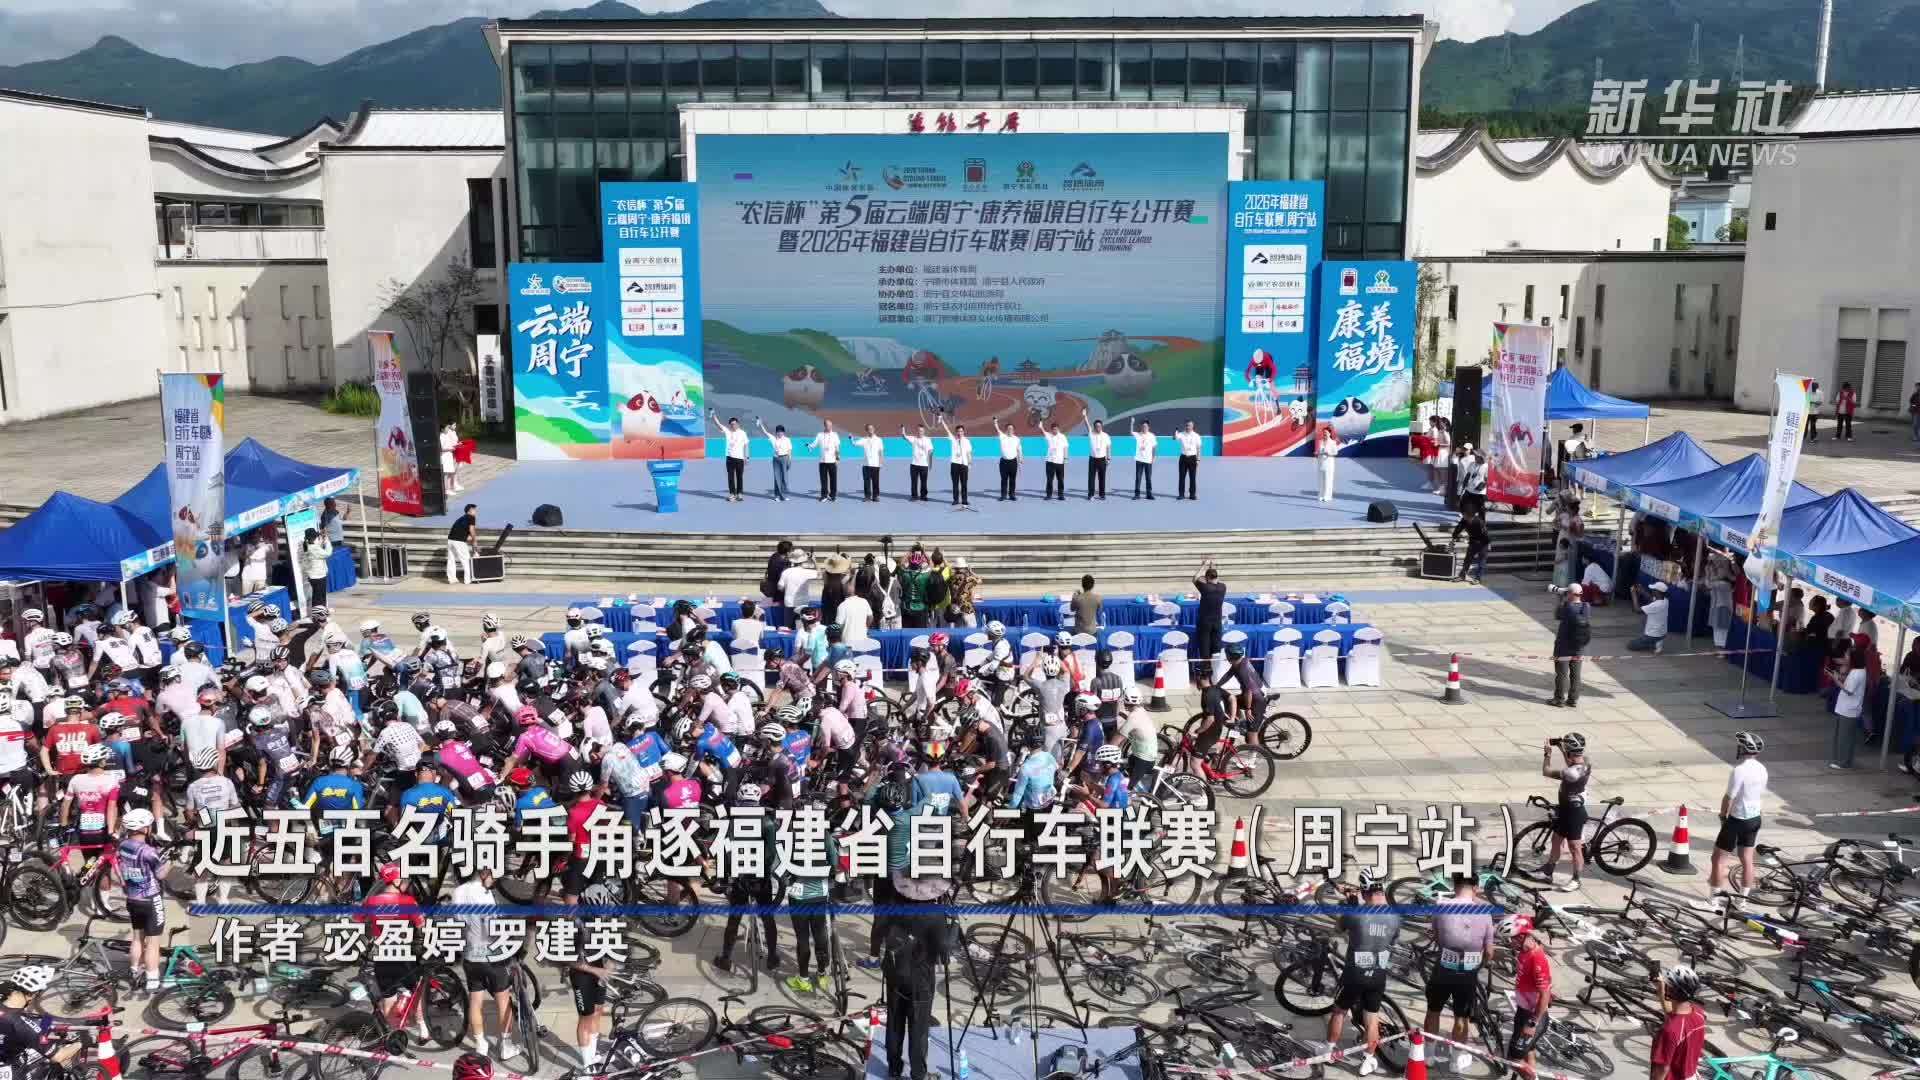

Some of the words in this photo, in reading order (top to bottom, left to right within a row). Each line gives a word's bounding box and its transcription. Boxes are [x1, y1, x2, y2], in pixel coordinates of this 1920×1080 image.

[1245, 194, 1308, 211] 2026年福建省
[619, 226, 680, 239] 自行车公开赛
[519, 301, 592, 339] 云端
[527, 338, 594, 377] 周宁
[1332, 341, 1404, 375] 福境
